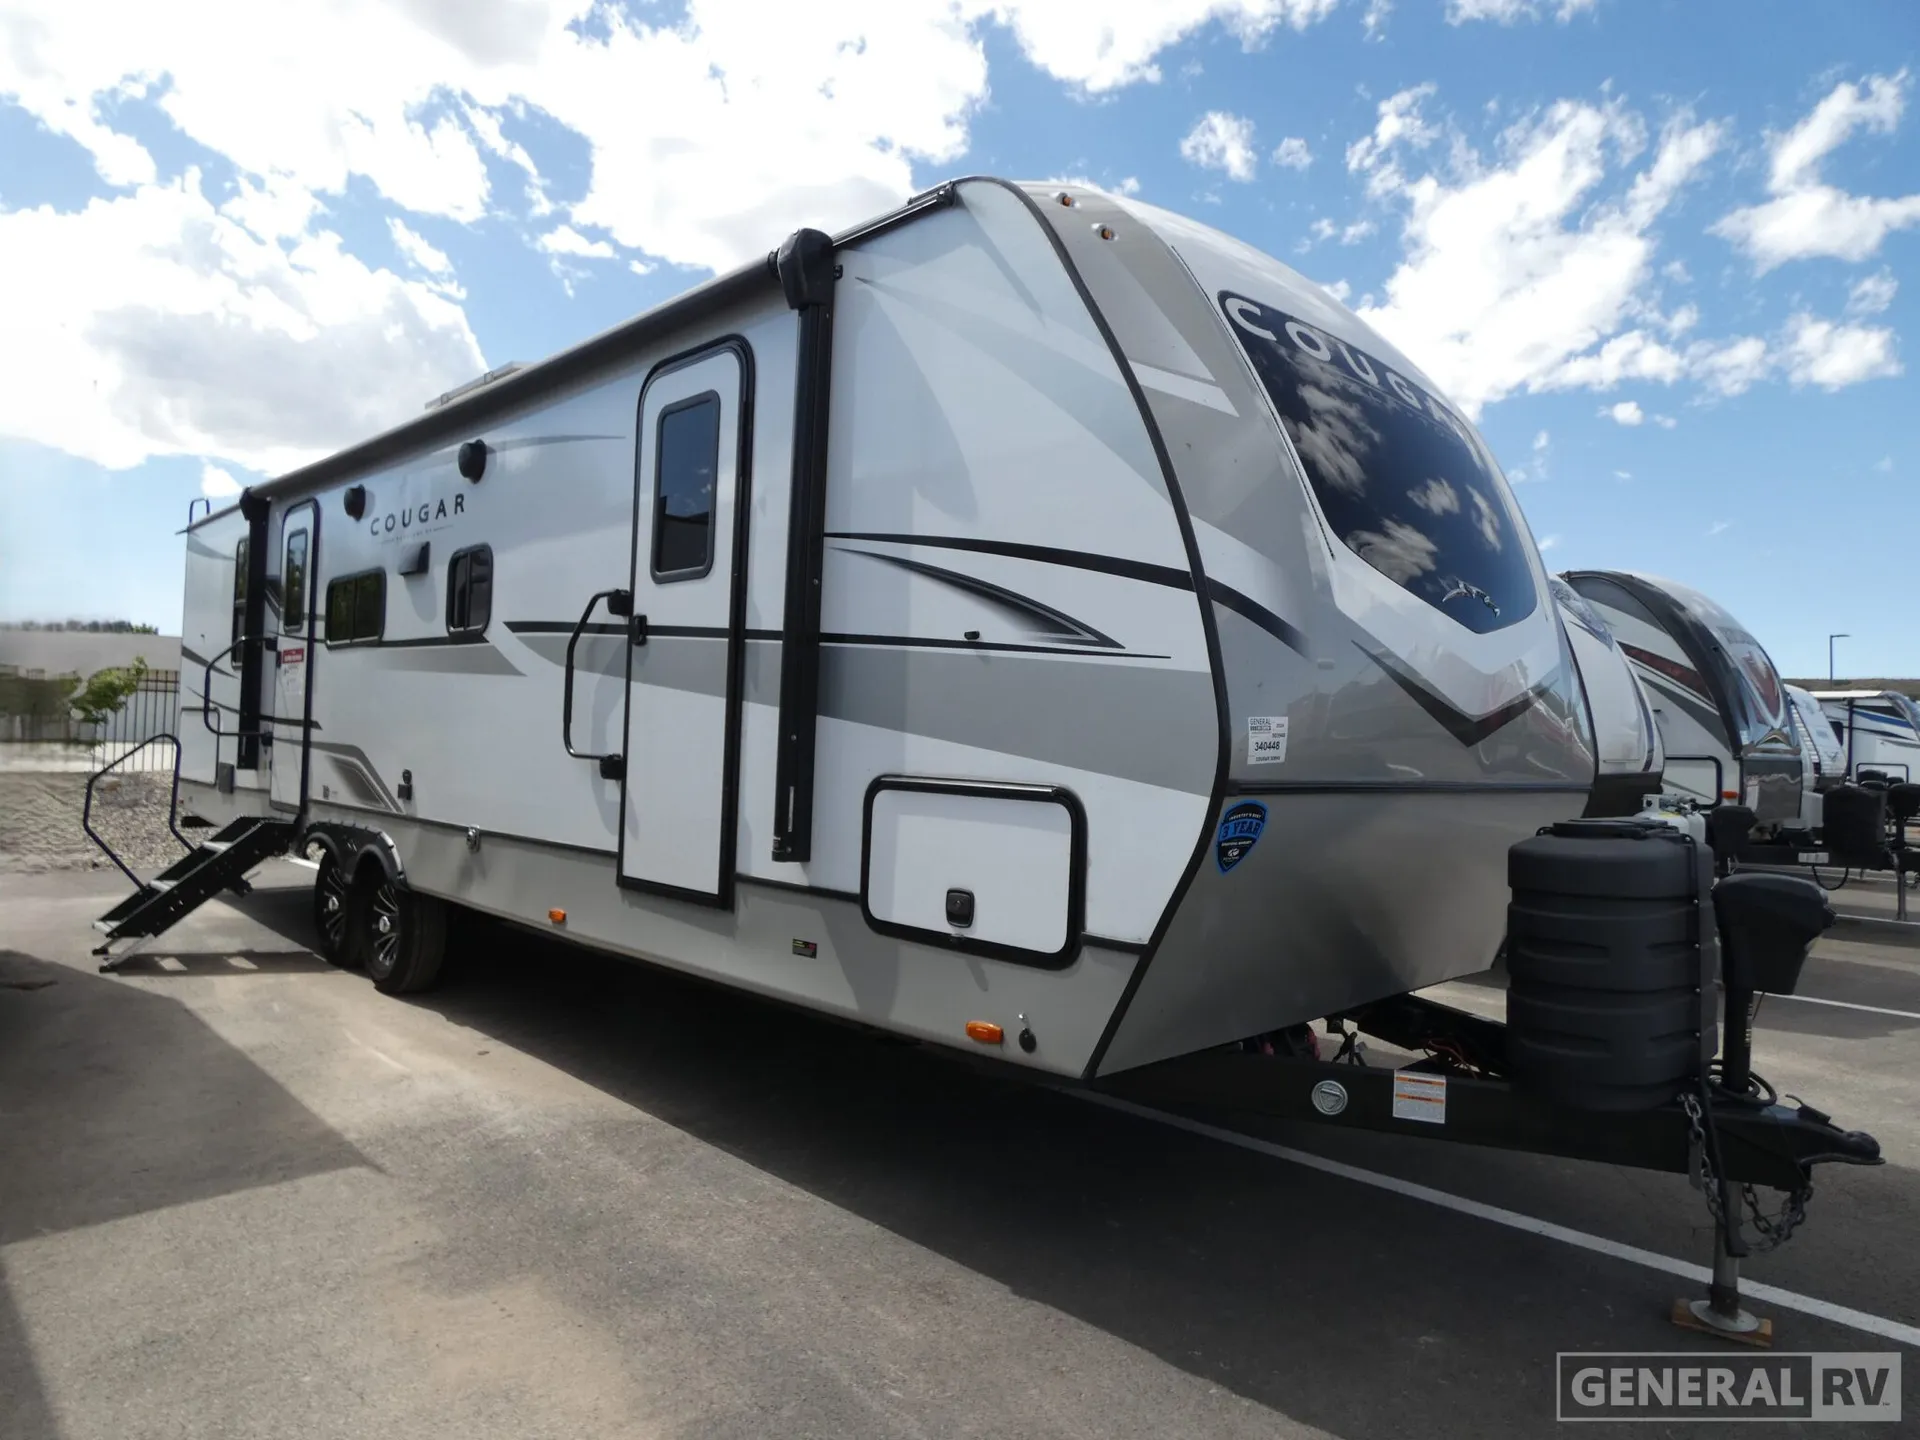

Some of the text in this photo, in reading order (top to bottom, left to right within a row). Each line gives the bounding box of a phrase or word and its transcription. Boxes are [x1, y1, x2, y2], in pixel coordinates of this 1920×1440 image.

[370, 493, 465, 536] COUGAR
[1249, 718, 1271, 726] GENERAL
[1254, 741, 1280, 751] 340448
[1222, 820, 1261, 838] 3 YEAR
